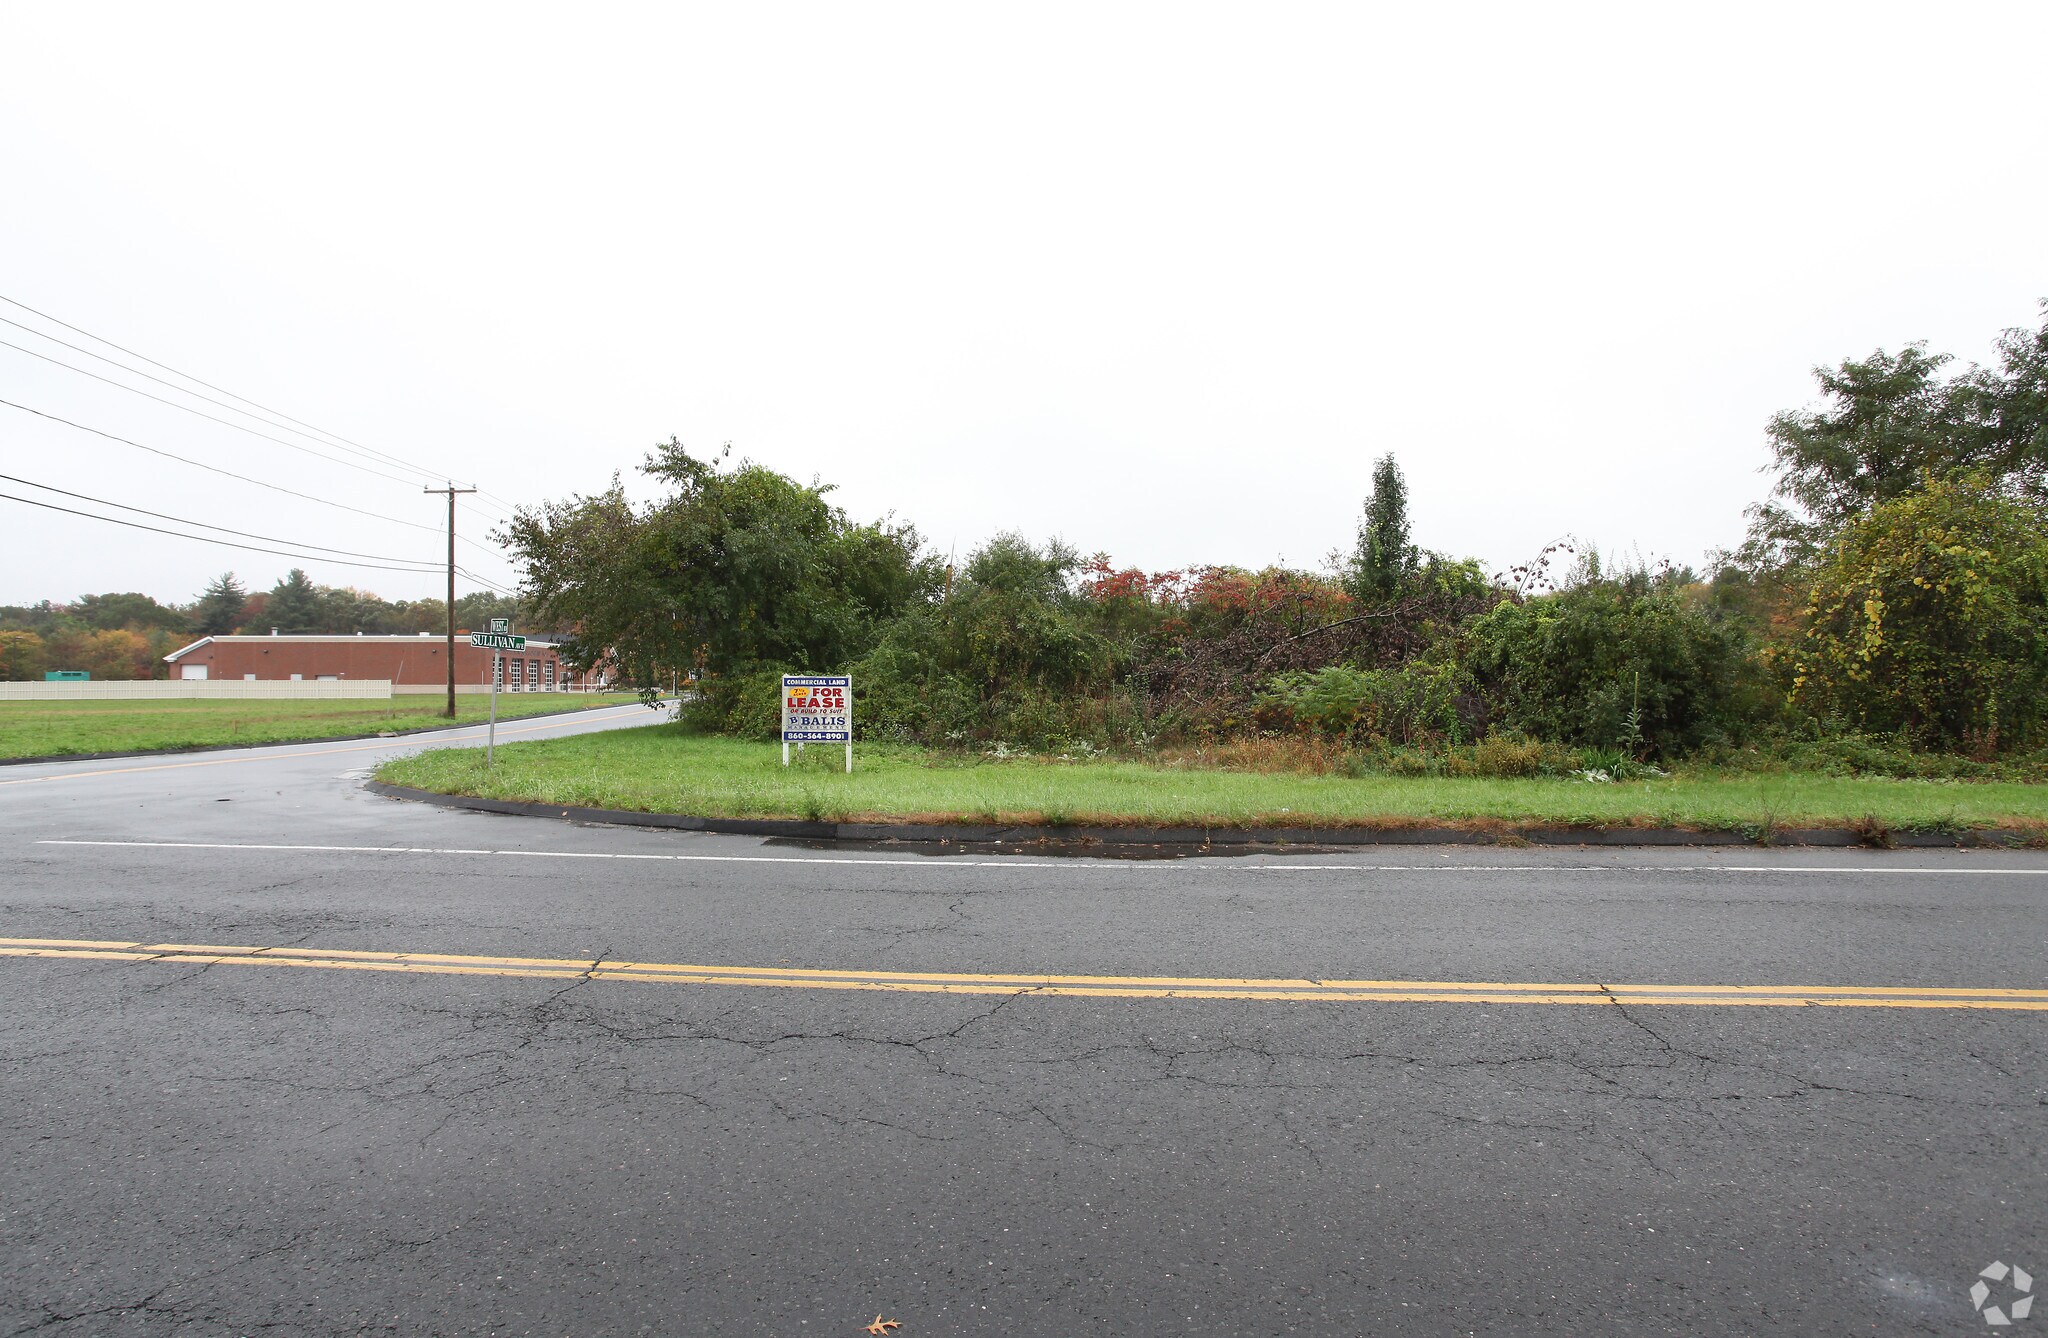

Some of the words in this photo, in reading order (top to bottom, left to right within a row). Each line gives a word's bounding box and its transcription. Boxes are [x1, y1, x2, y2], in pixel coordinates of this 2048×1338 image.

[492, 621, 504, 631] WEST
[472, 634, 515, 648] SULLIVAN
[812, 688, 842, 696] FOR
[788, 698, 844, 708] LEASE
[801, 716, 845, 726] BALIS
